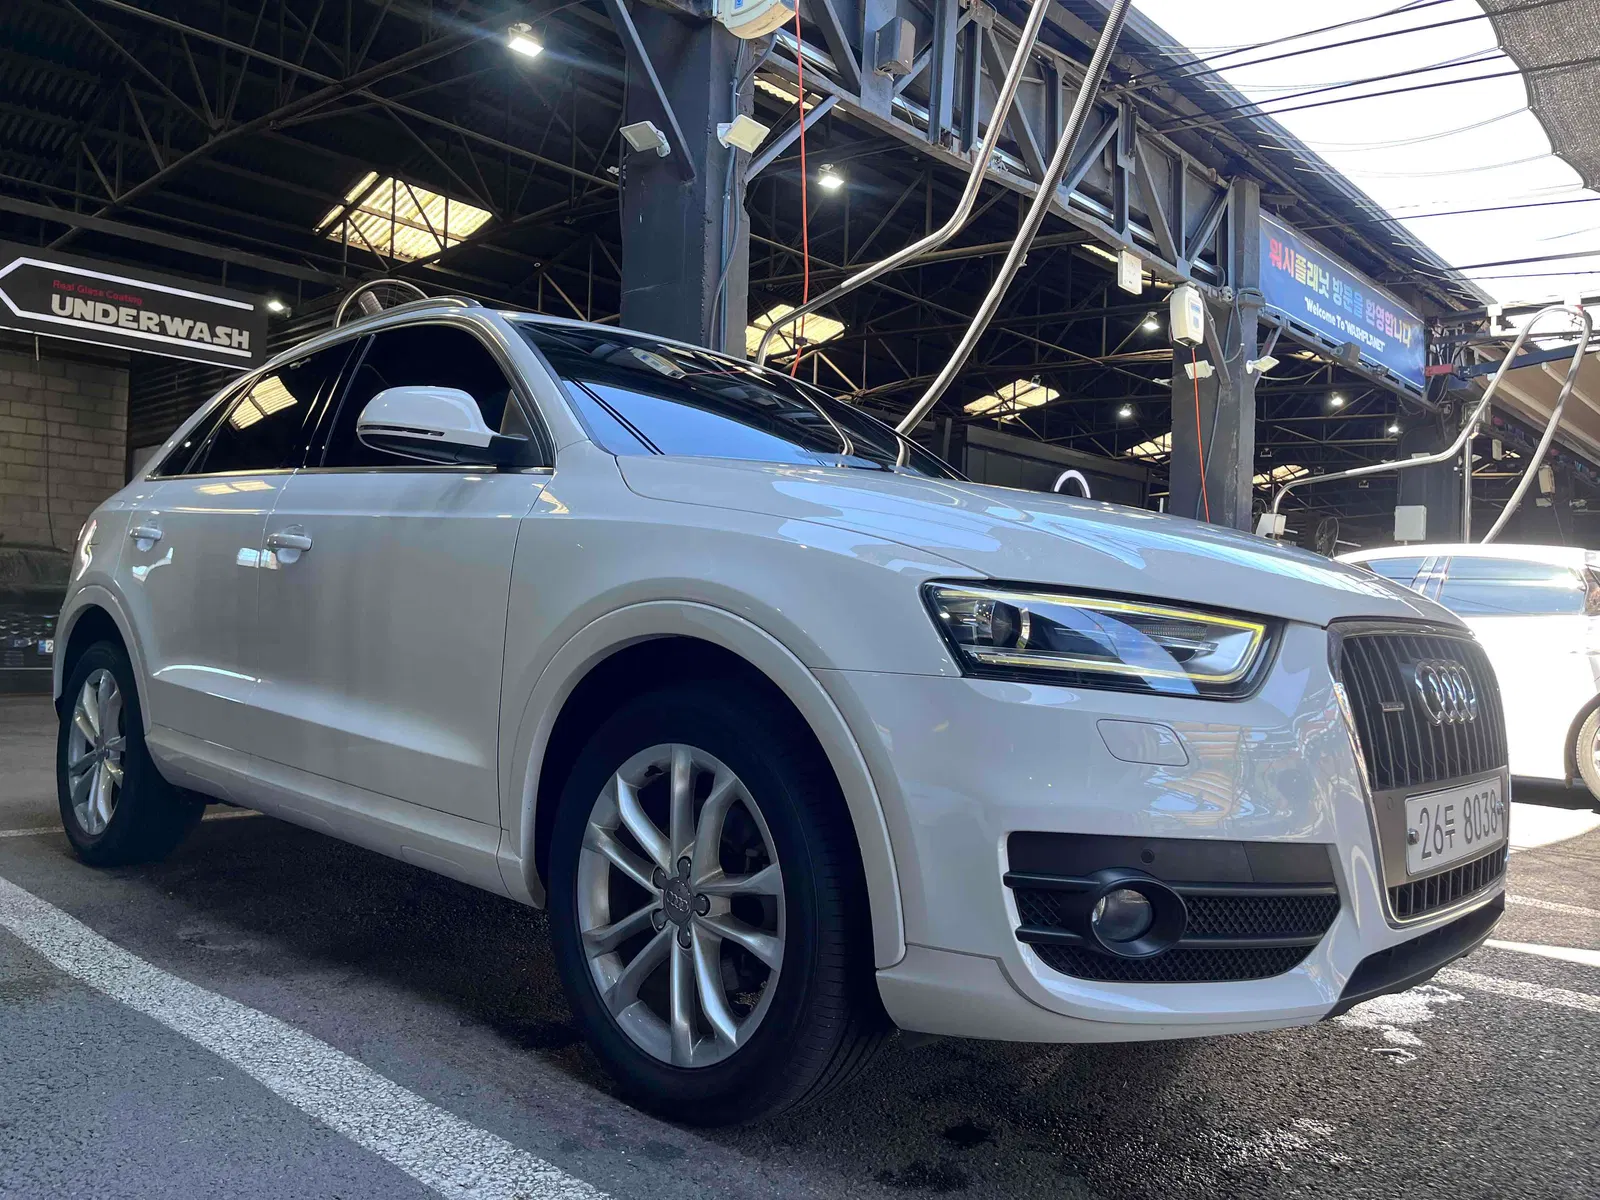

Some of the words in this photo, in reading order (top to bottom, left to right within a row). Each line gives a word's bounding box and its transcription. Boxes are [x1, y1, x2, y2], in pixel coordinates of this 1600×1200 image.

[52, 280, 75, 292] Real
[77, 284, 104, 297] Glass
[105, 290, 143, 305] Coating
[1269, 238, 1330, 298] 워시플래닛
[1332, 276, 1363, 319] 방문을
[1365, 298, 1411, 348] 환영합니다
[51, 293, 250, 350] UNDERWASH
[1304, 296, 1336, 326] Welcome
[1336, 314, 1346, 331] To
[1344, 319, 1386, 353] WASHPLANET
[1419, 804, 1456, 860] 26두
[1463, 789, 1499, 844] 8038
